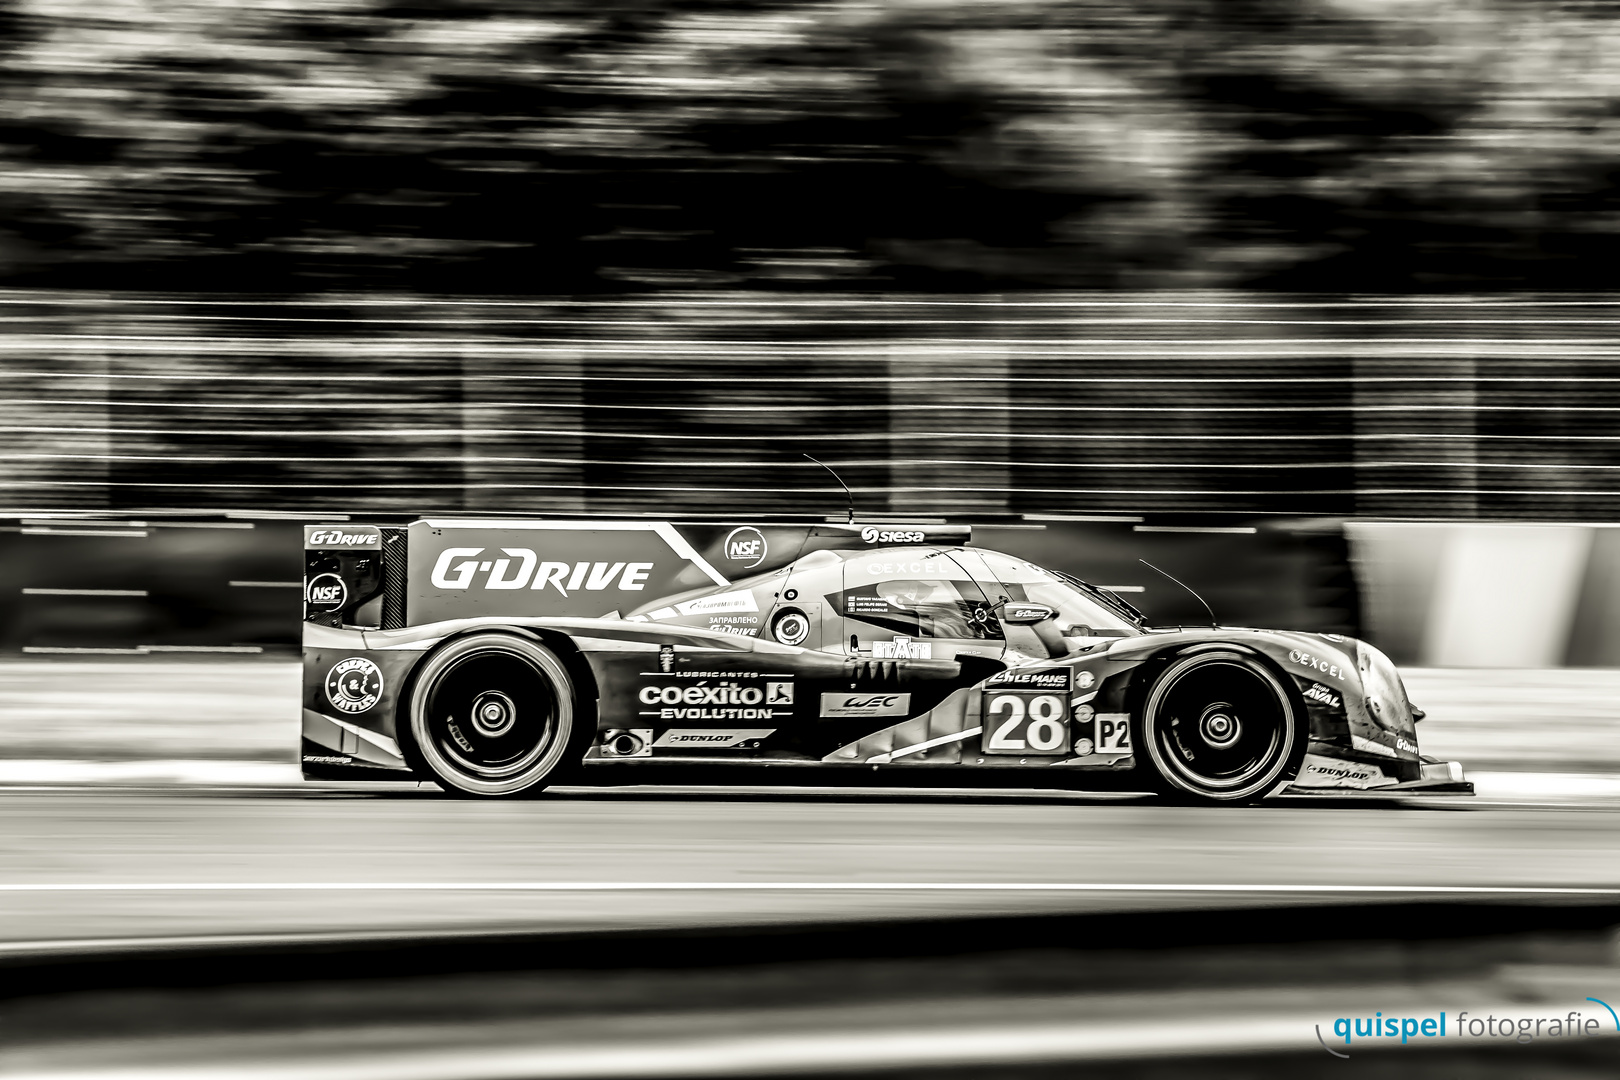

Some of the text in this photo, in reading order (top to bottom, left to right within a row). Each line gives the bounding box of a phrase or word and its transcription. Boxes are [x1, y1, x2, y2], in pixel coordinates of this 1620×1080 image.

[878, 531, 925, 543] siesa
[730, 539, 761, 555] NSF
[884, 562, 948, 573] EXCEL
[311, 585, 342, 600] NSF
[708, 616, 758, 624] ЗАПРАВЛЕНО
[1299, 652, 1346, 681] EXCEL
[1031, 674, 1068, 683] MANS
[638, 680, 764, 705] coéxito
[1302, 688, 1341, 708] AVAL
[843, 695, 900, 708] WEC
[660, 708, 773, 719] EVOLUTION
[988, 695, 1065, 751] 28
[1100, 720, 1130, 748] P2
[1316, 766, 1369, 780] DUNLOP
